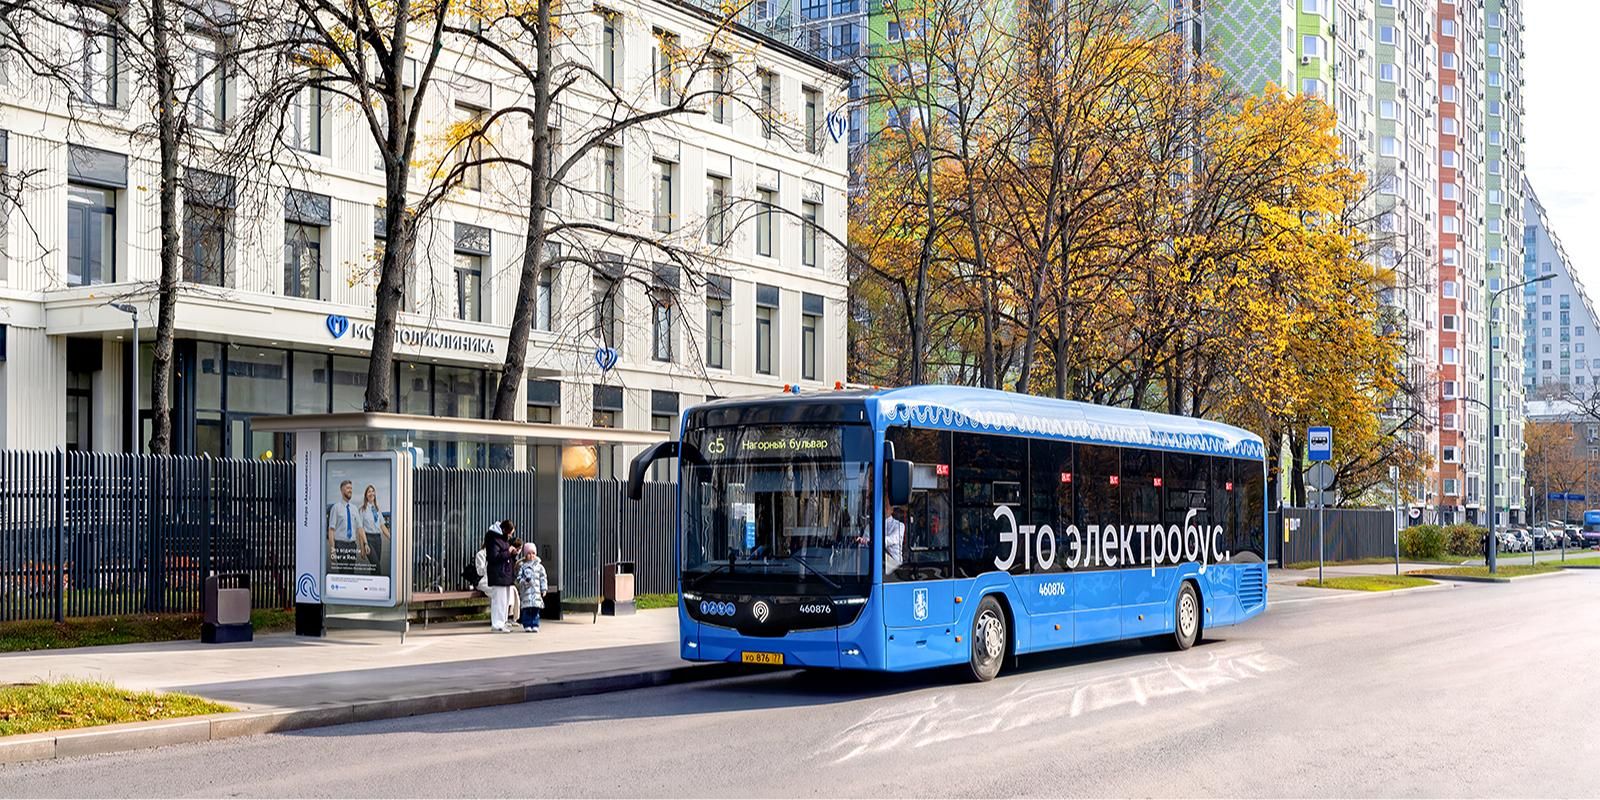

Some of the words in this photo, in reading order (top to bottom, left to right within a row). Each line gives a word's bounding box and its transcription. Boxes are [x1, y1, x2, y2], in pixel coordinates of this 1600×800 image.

[352, 323, 495, 353] МООЛИКЛИНИКА
[742, 439, 786, 451] Нагорный
[789, 438, 828, 451] бульвар
[993, 505, 1056, 571] Это
[1066, 508, 1230, 577] электробус.
[1038, 582, 1066, 596] 460876
[800, 604, 831, 614] 460876
[756, 653, 770, 663] 876
